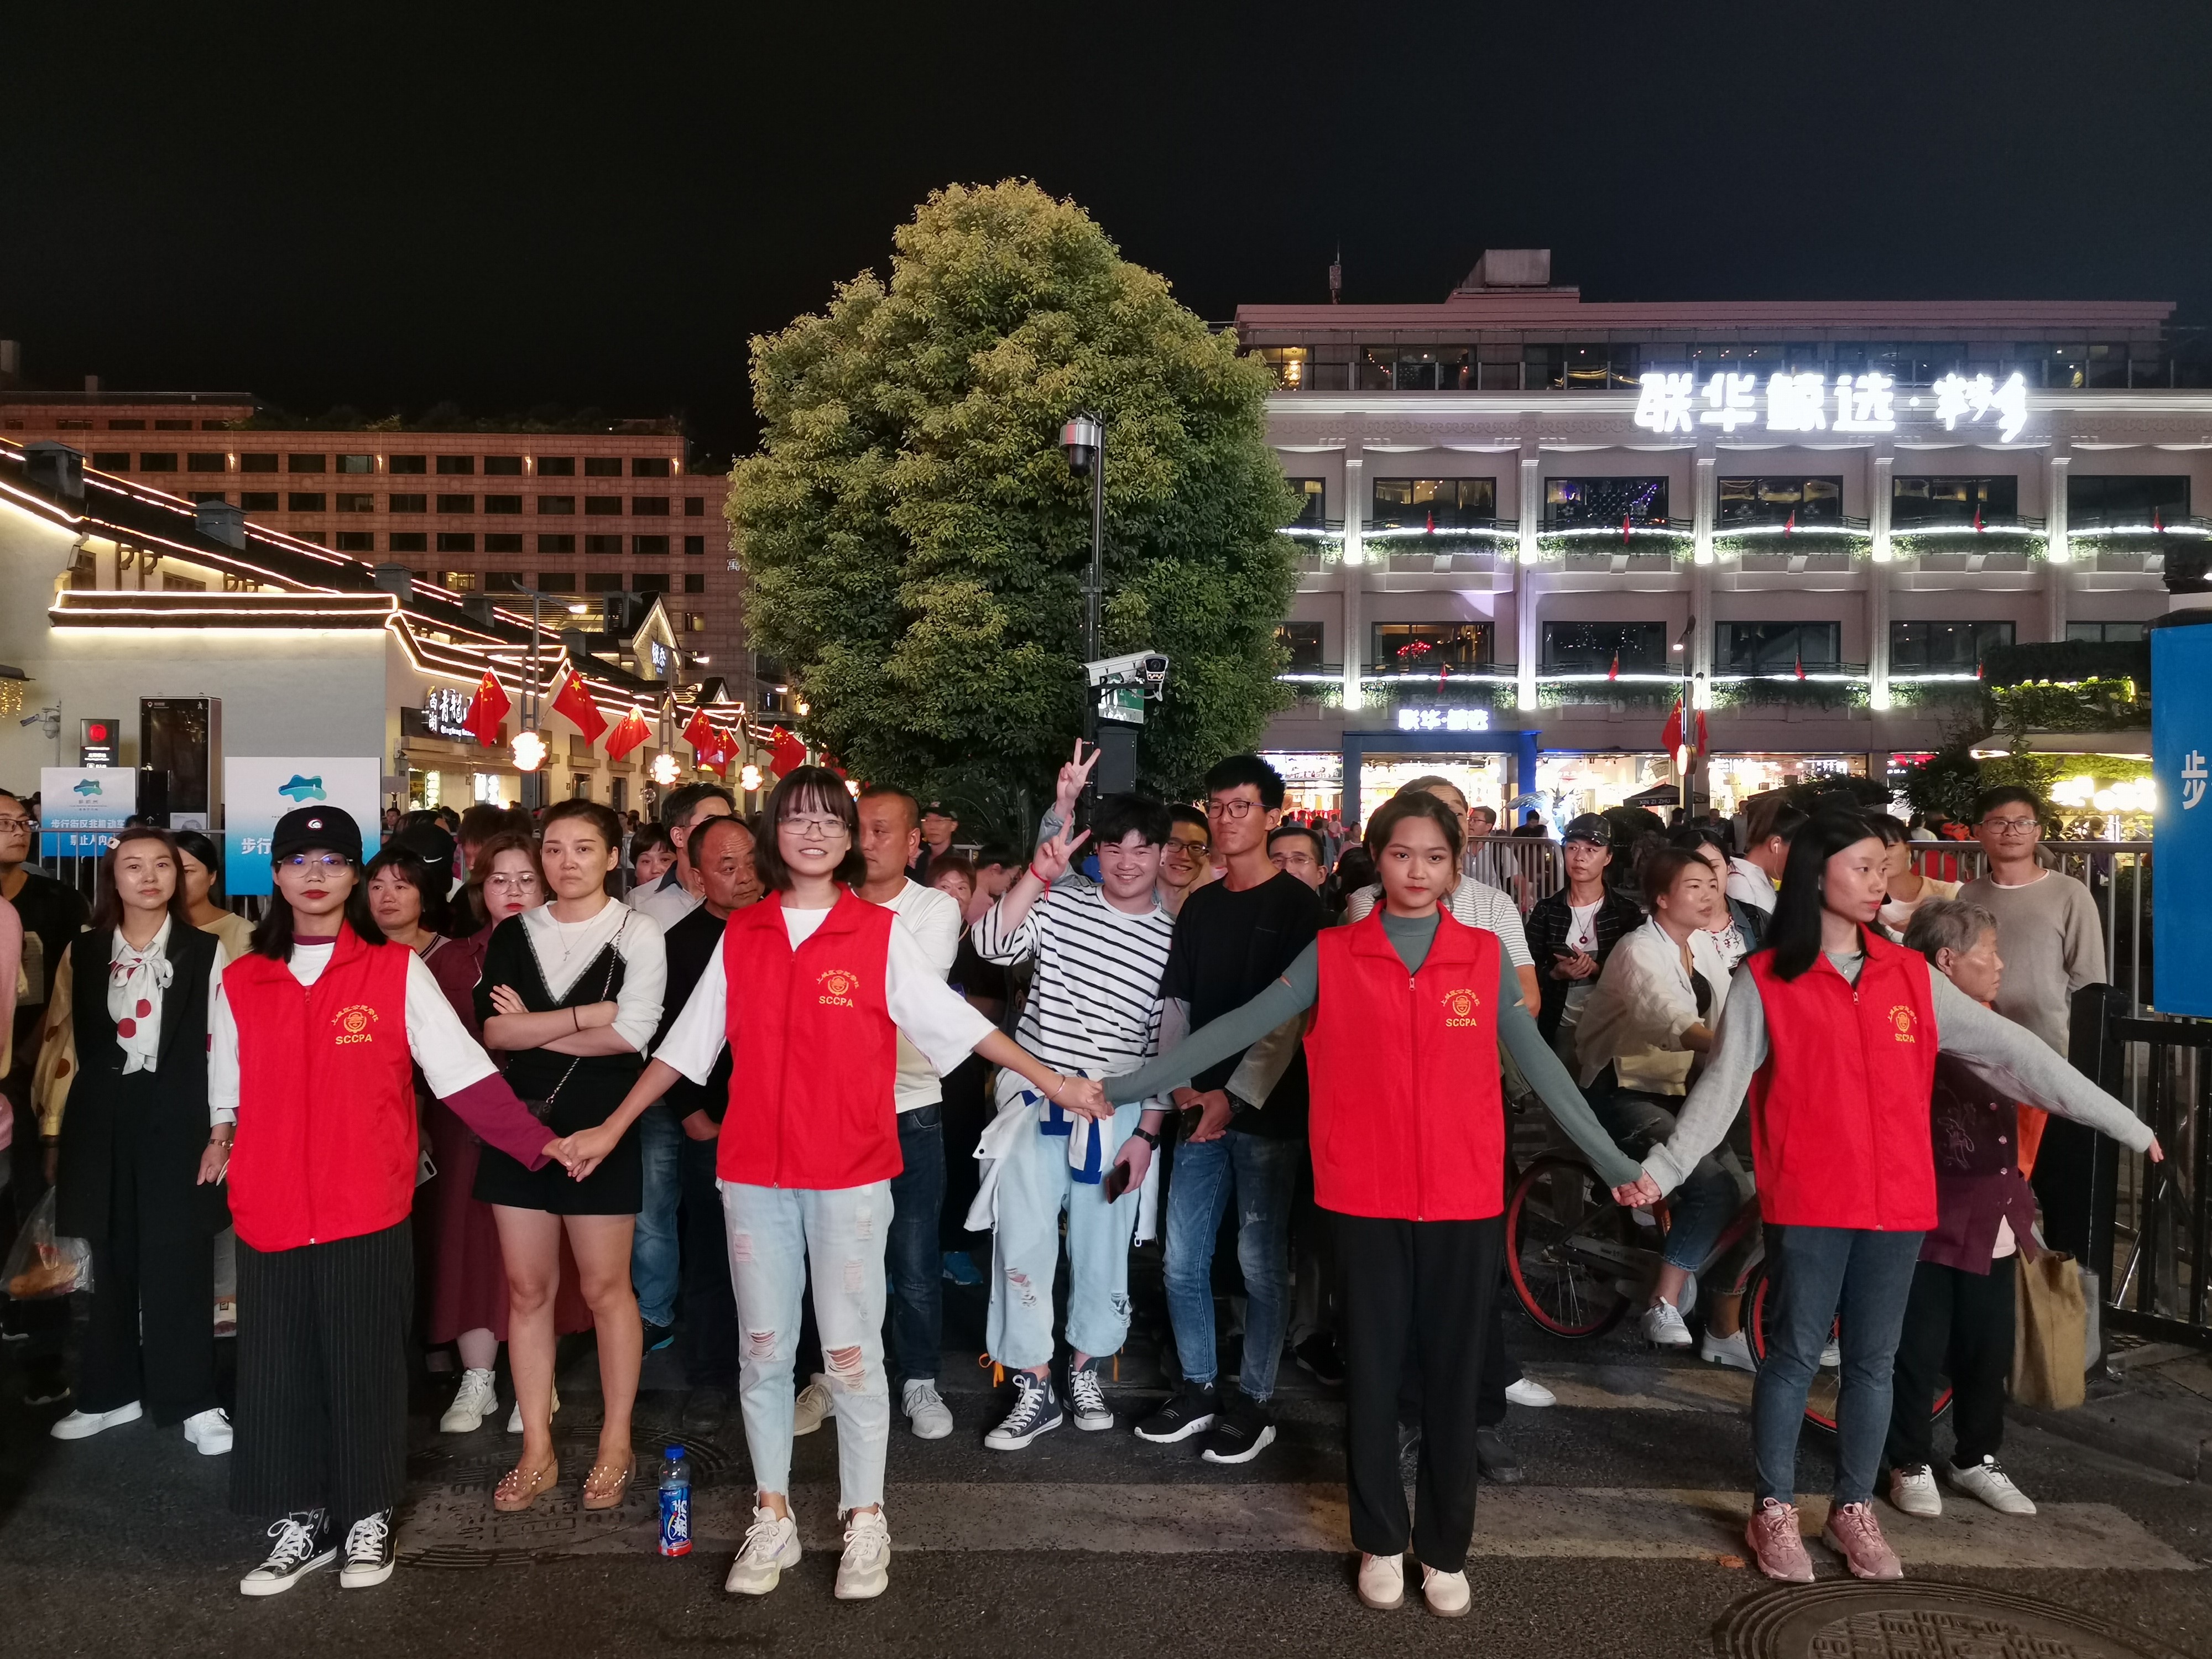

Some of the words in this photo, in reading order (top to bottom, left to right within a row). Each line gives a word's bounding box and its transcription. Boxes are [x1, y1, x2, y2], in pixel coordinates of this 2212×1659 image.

[818, 995, 854, 1008] SCCPA
[1445, 1018, 1477, 1027] SCCPA
[335, 1034, 373, 1045] SCCPA
